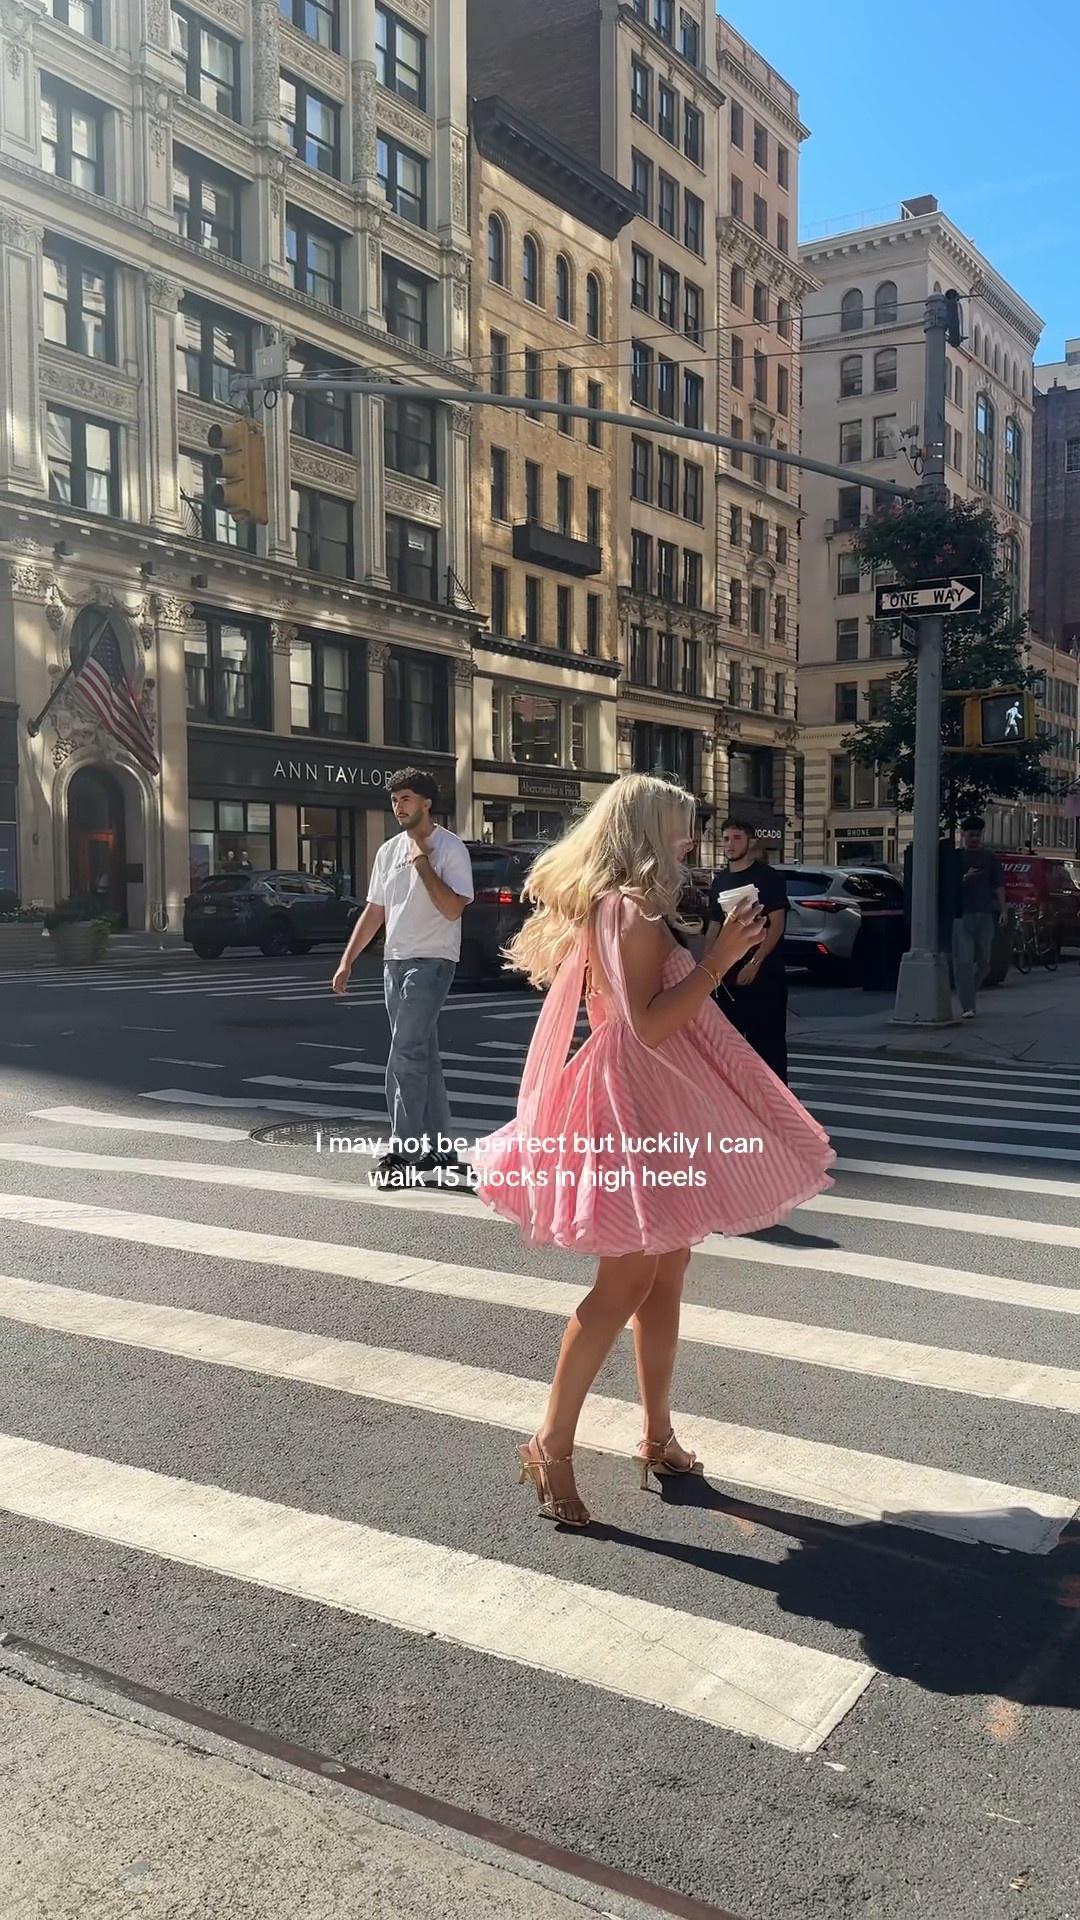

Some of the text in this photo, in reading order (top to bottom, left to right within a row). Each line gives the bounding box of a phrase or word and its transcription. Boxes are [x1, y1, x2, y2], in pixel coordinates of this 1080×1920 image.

[889, 587, 965, 607] ONE WAY
[273, 760, 318, 780] ANN
